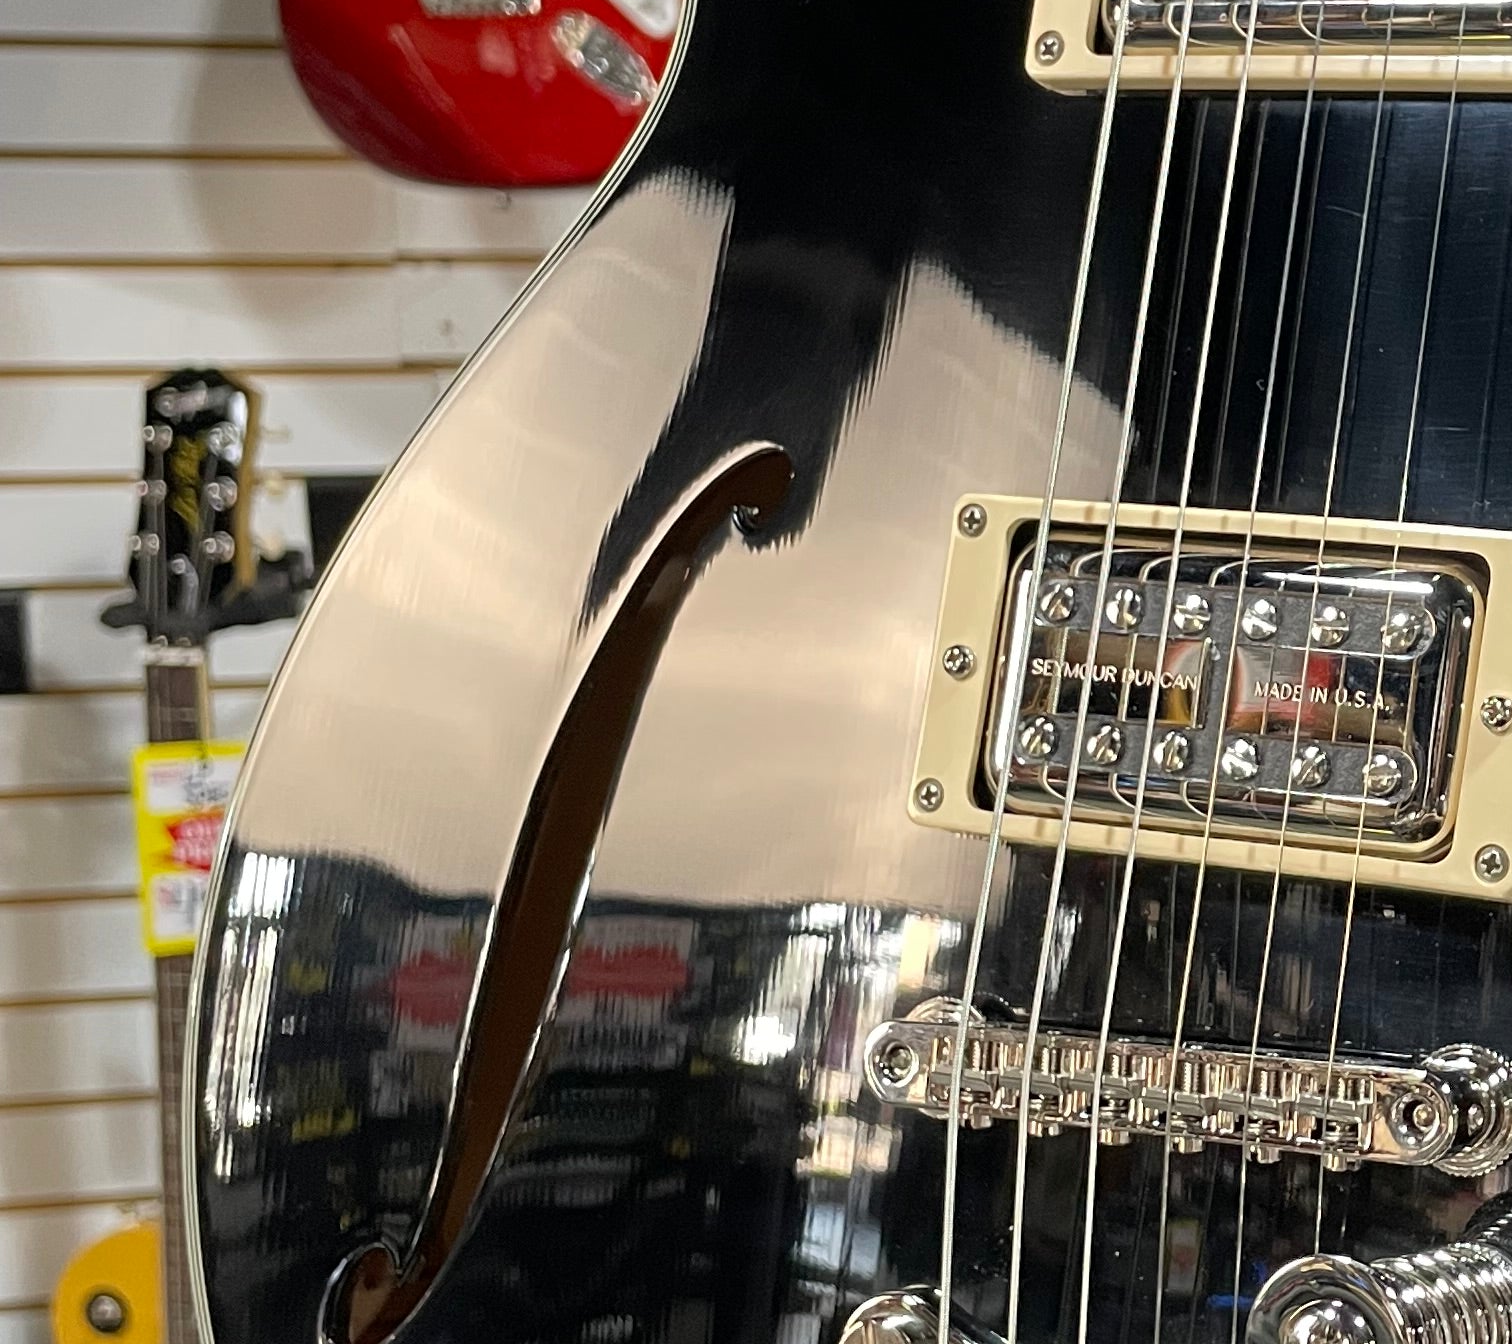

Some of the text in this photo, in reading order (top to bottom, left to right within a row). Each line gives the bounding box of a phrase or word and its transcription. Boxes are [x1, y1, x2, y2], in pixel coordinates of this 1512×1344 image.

[1254, 681, 1391, 712] MADE IN U.S.A.
